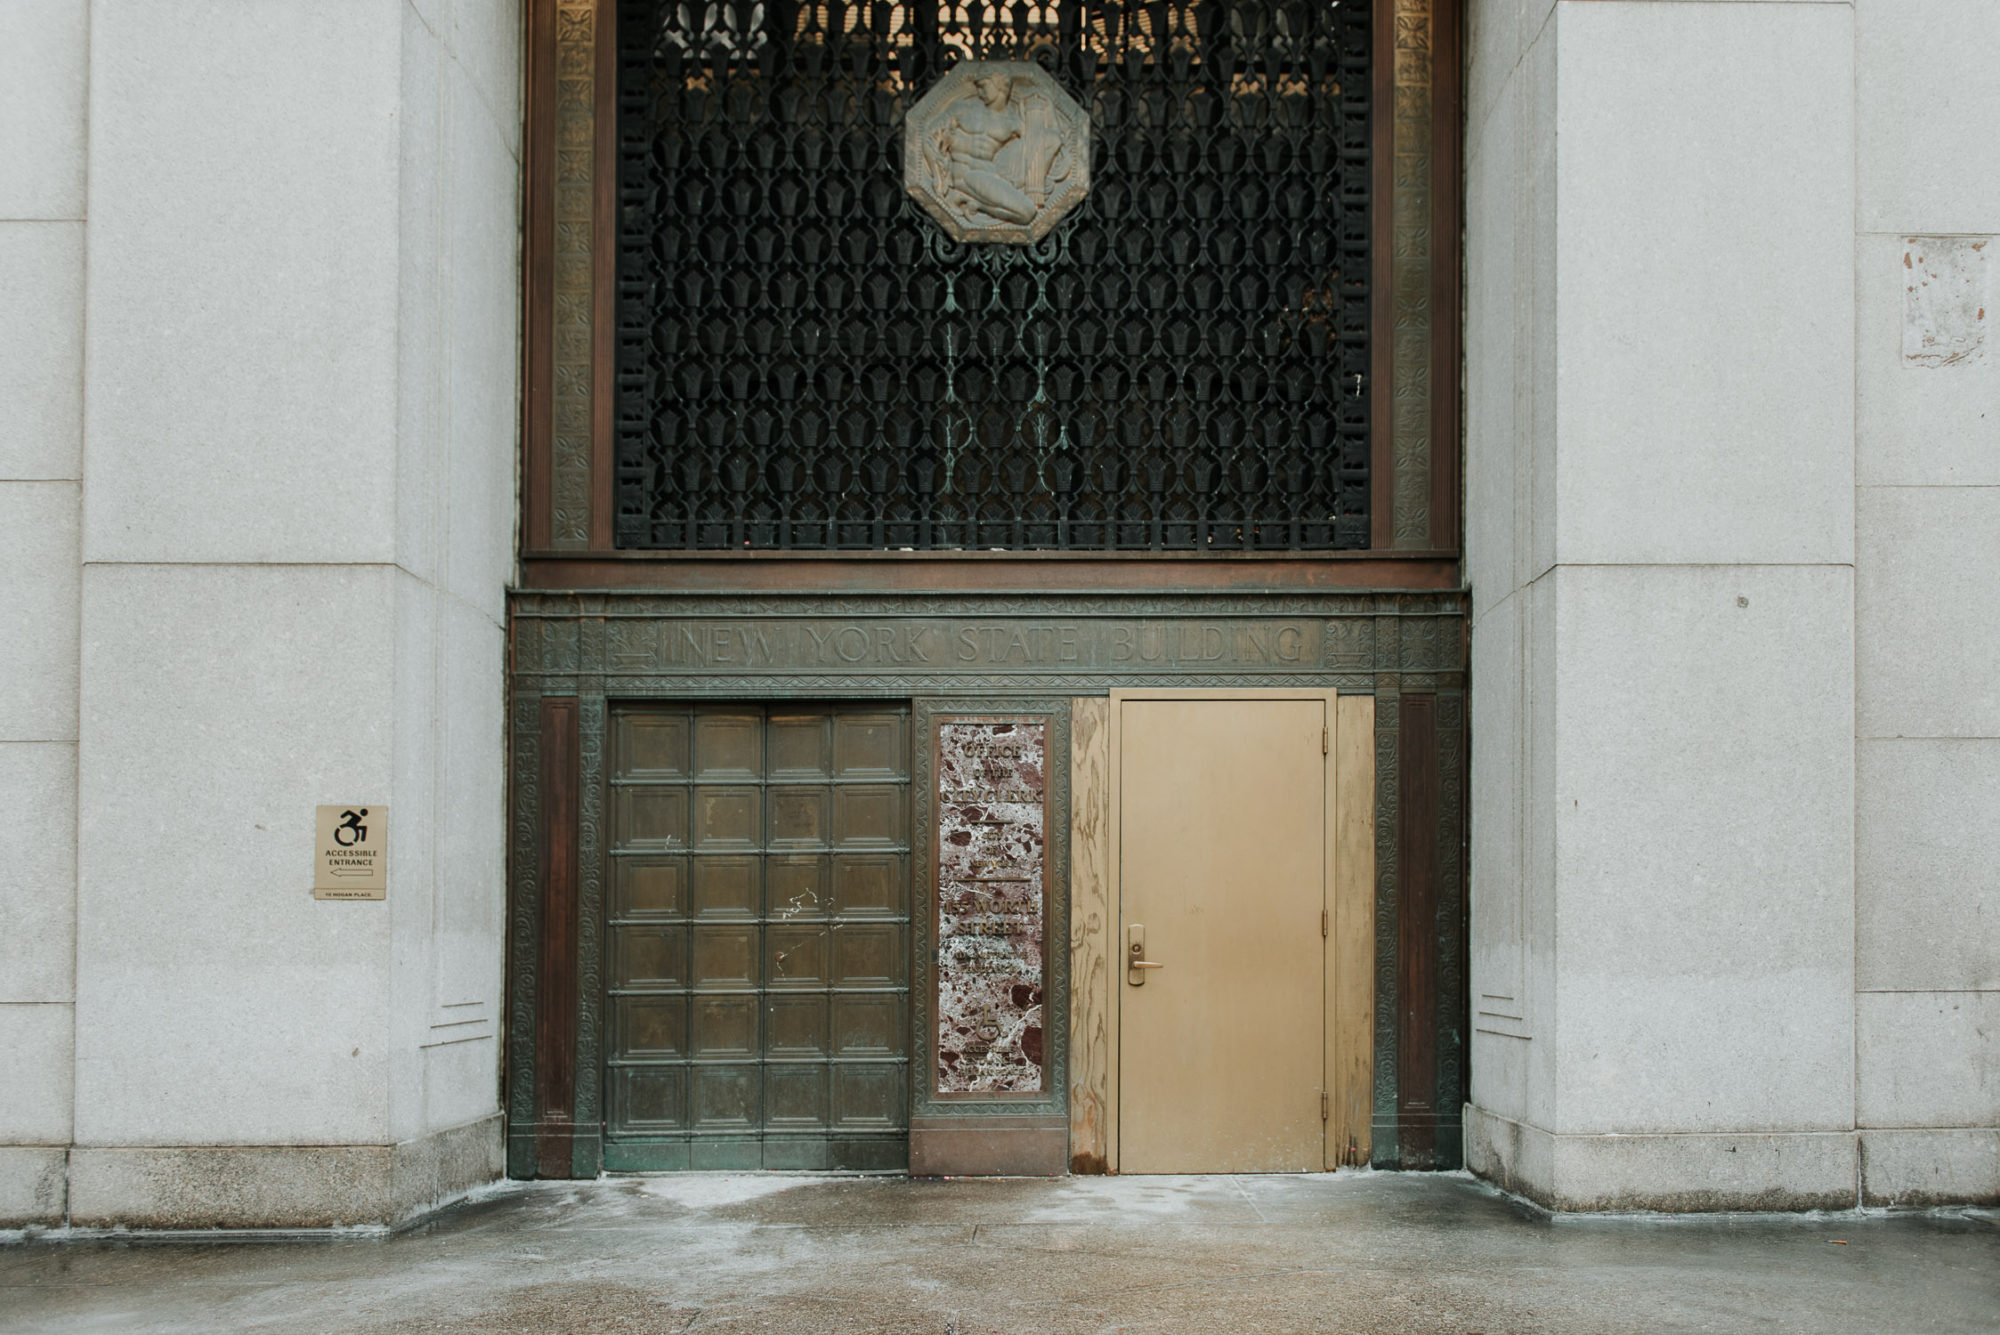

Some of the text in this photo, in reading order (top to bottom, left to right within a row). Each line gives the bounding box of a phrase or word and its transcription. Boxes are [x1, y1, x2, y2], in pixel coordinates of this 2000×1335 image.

[679, 625, 1303, 667] NEW YORK STATE BUILDING
[963, 745, 1022, 759] OFFICE
[983, 790, 1042, 804] CLERK
[944, 900, 1038, 914] 155 WORTH
[957, 921, 1022, 936] STREET
